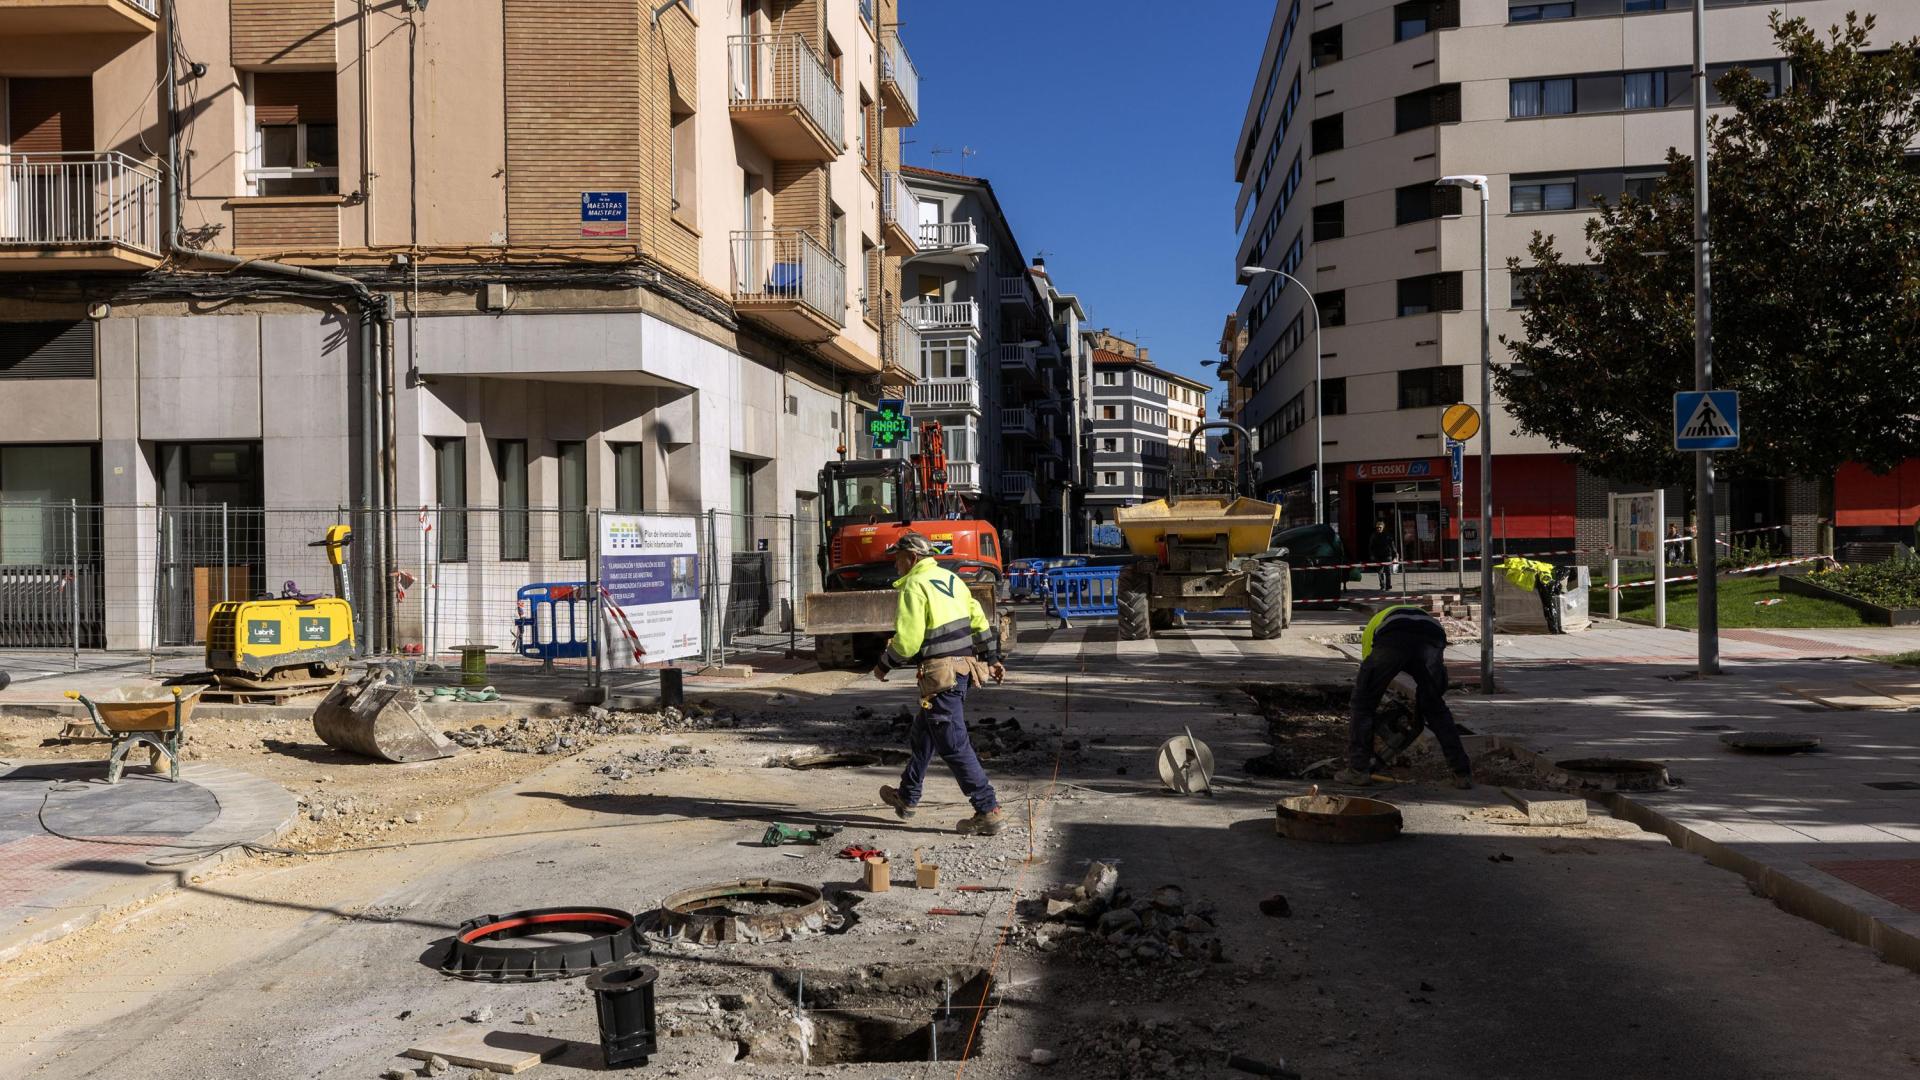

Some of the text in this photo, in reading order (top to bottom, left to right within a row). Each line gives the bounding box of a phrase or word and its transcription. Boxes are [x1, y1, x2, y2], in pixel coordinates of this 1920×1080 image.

[1371, 464, 1405, 475] EROSKI
[254, 628, 275, 636] Labrit
[305, 625, 325, 633] Labrit
